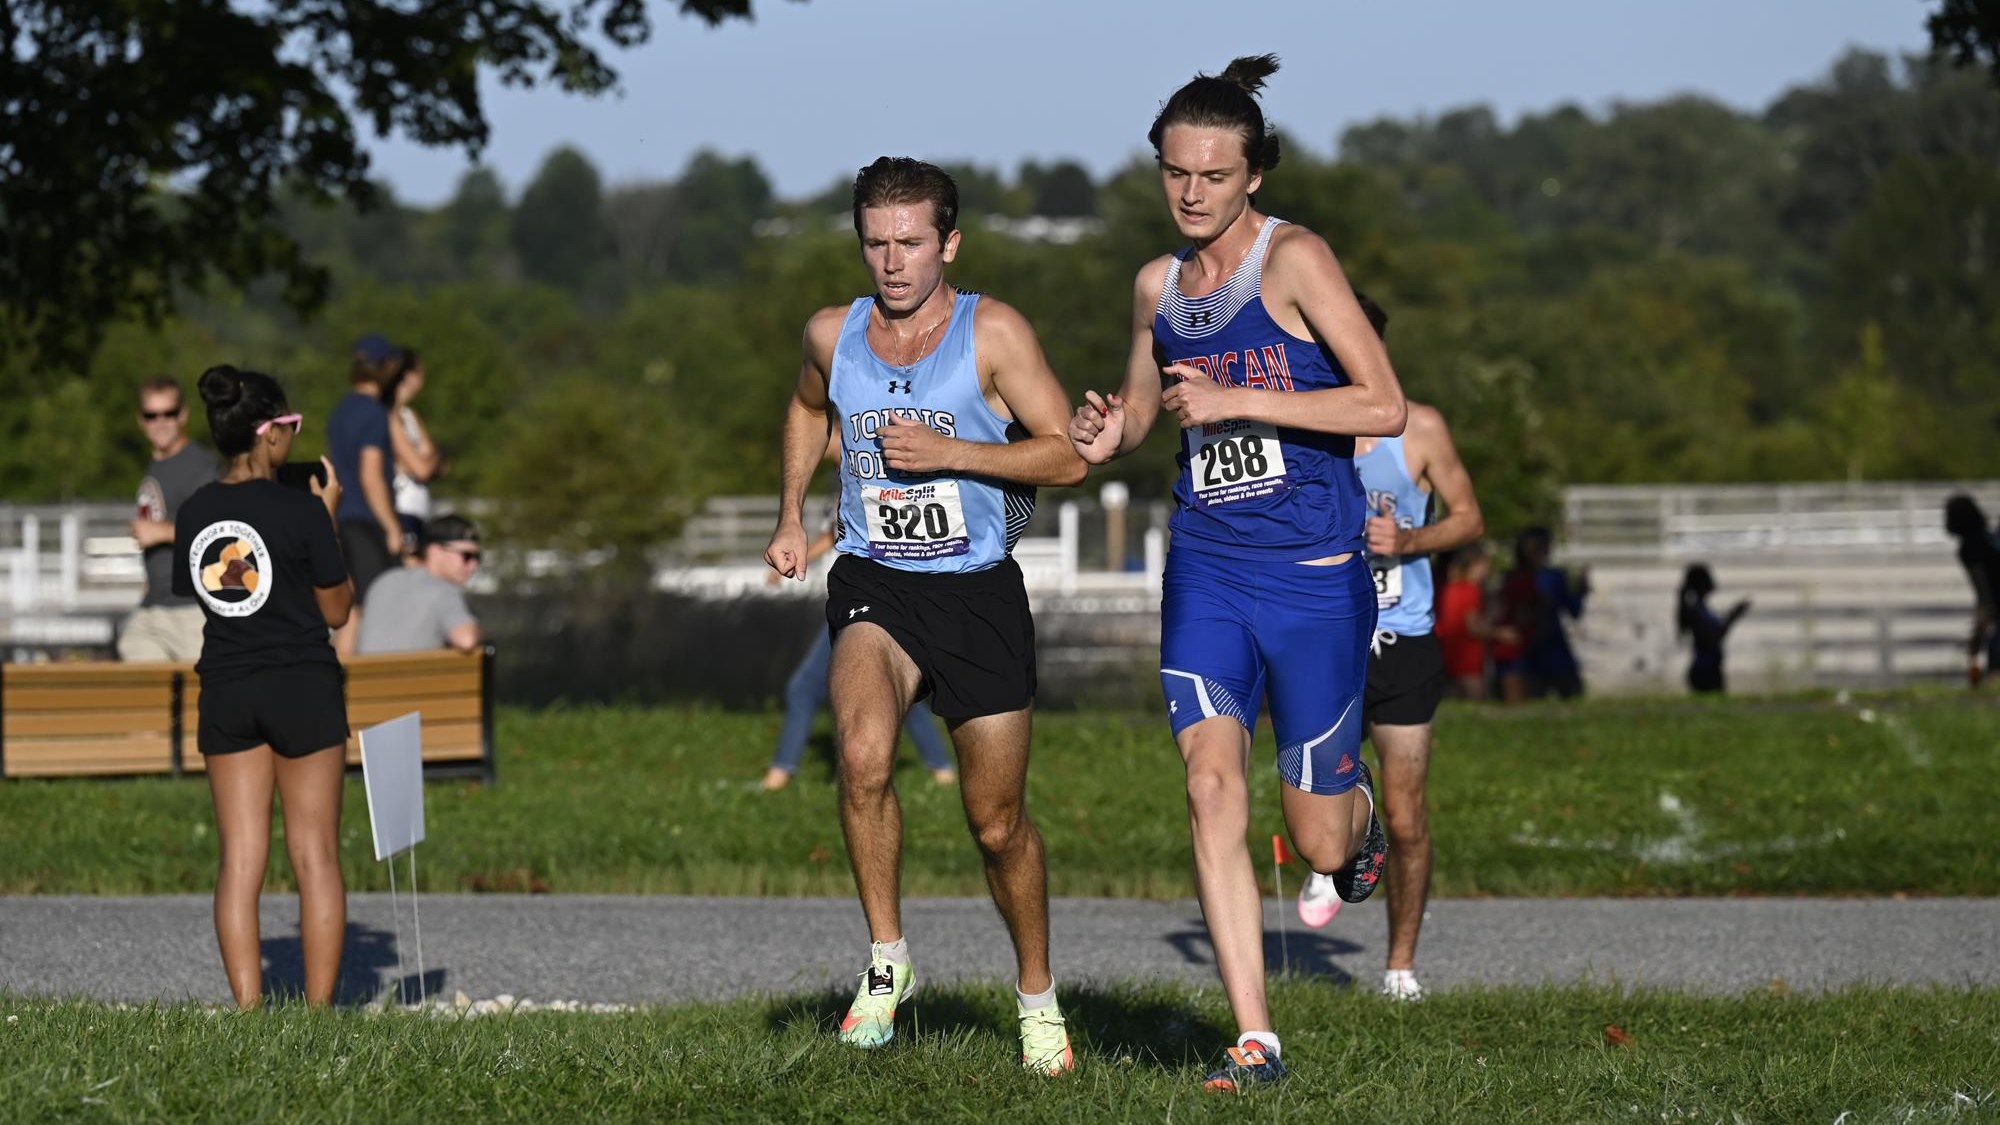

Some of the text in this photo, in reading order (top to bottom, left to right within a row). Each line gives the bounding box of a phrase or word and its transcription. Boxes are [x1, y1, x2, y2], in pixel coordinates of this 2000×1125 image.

[1172, 343, 1295, 391] ICAN
[1200, 435, 1268, 486] 298
[1251, 482, 1263, 490] race
[1256, 487, 1274, 496] events
[879, 485, 936, 502] MileSplit
[879, 503, 950, 541] 320
[908, 544, 931, 553] rankings,
[936, 547, 954, 556] events
